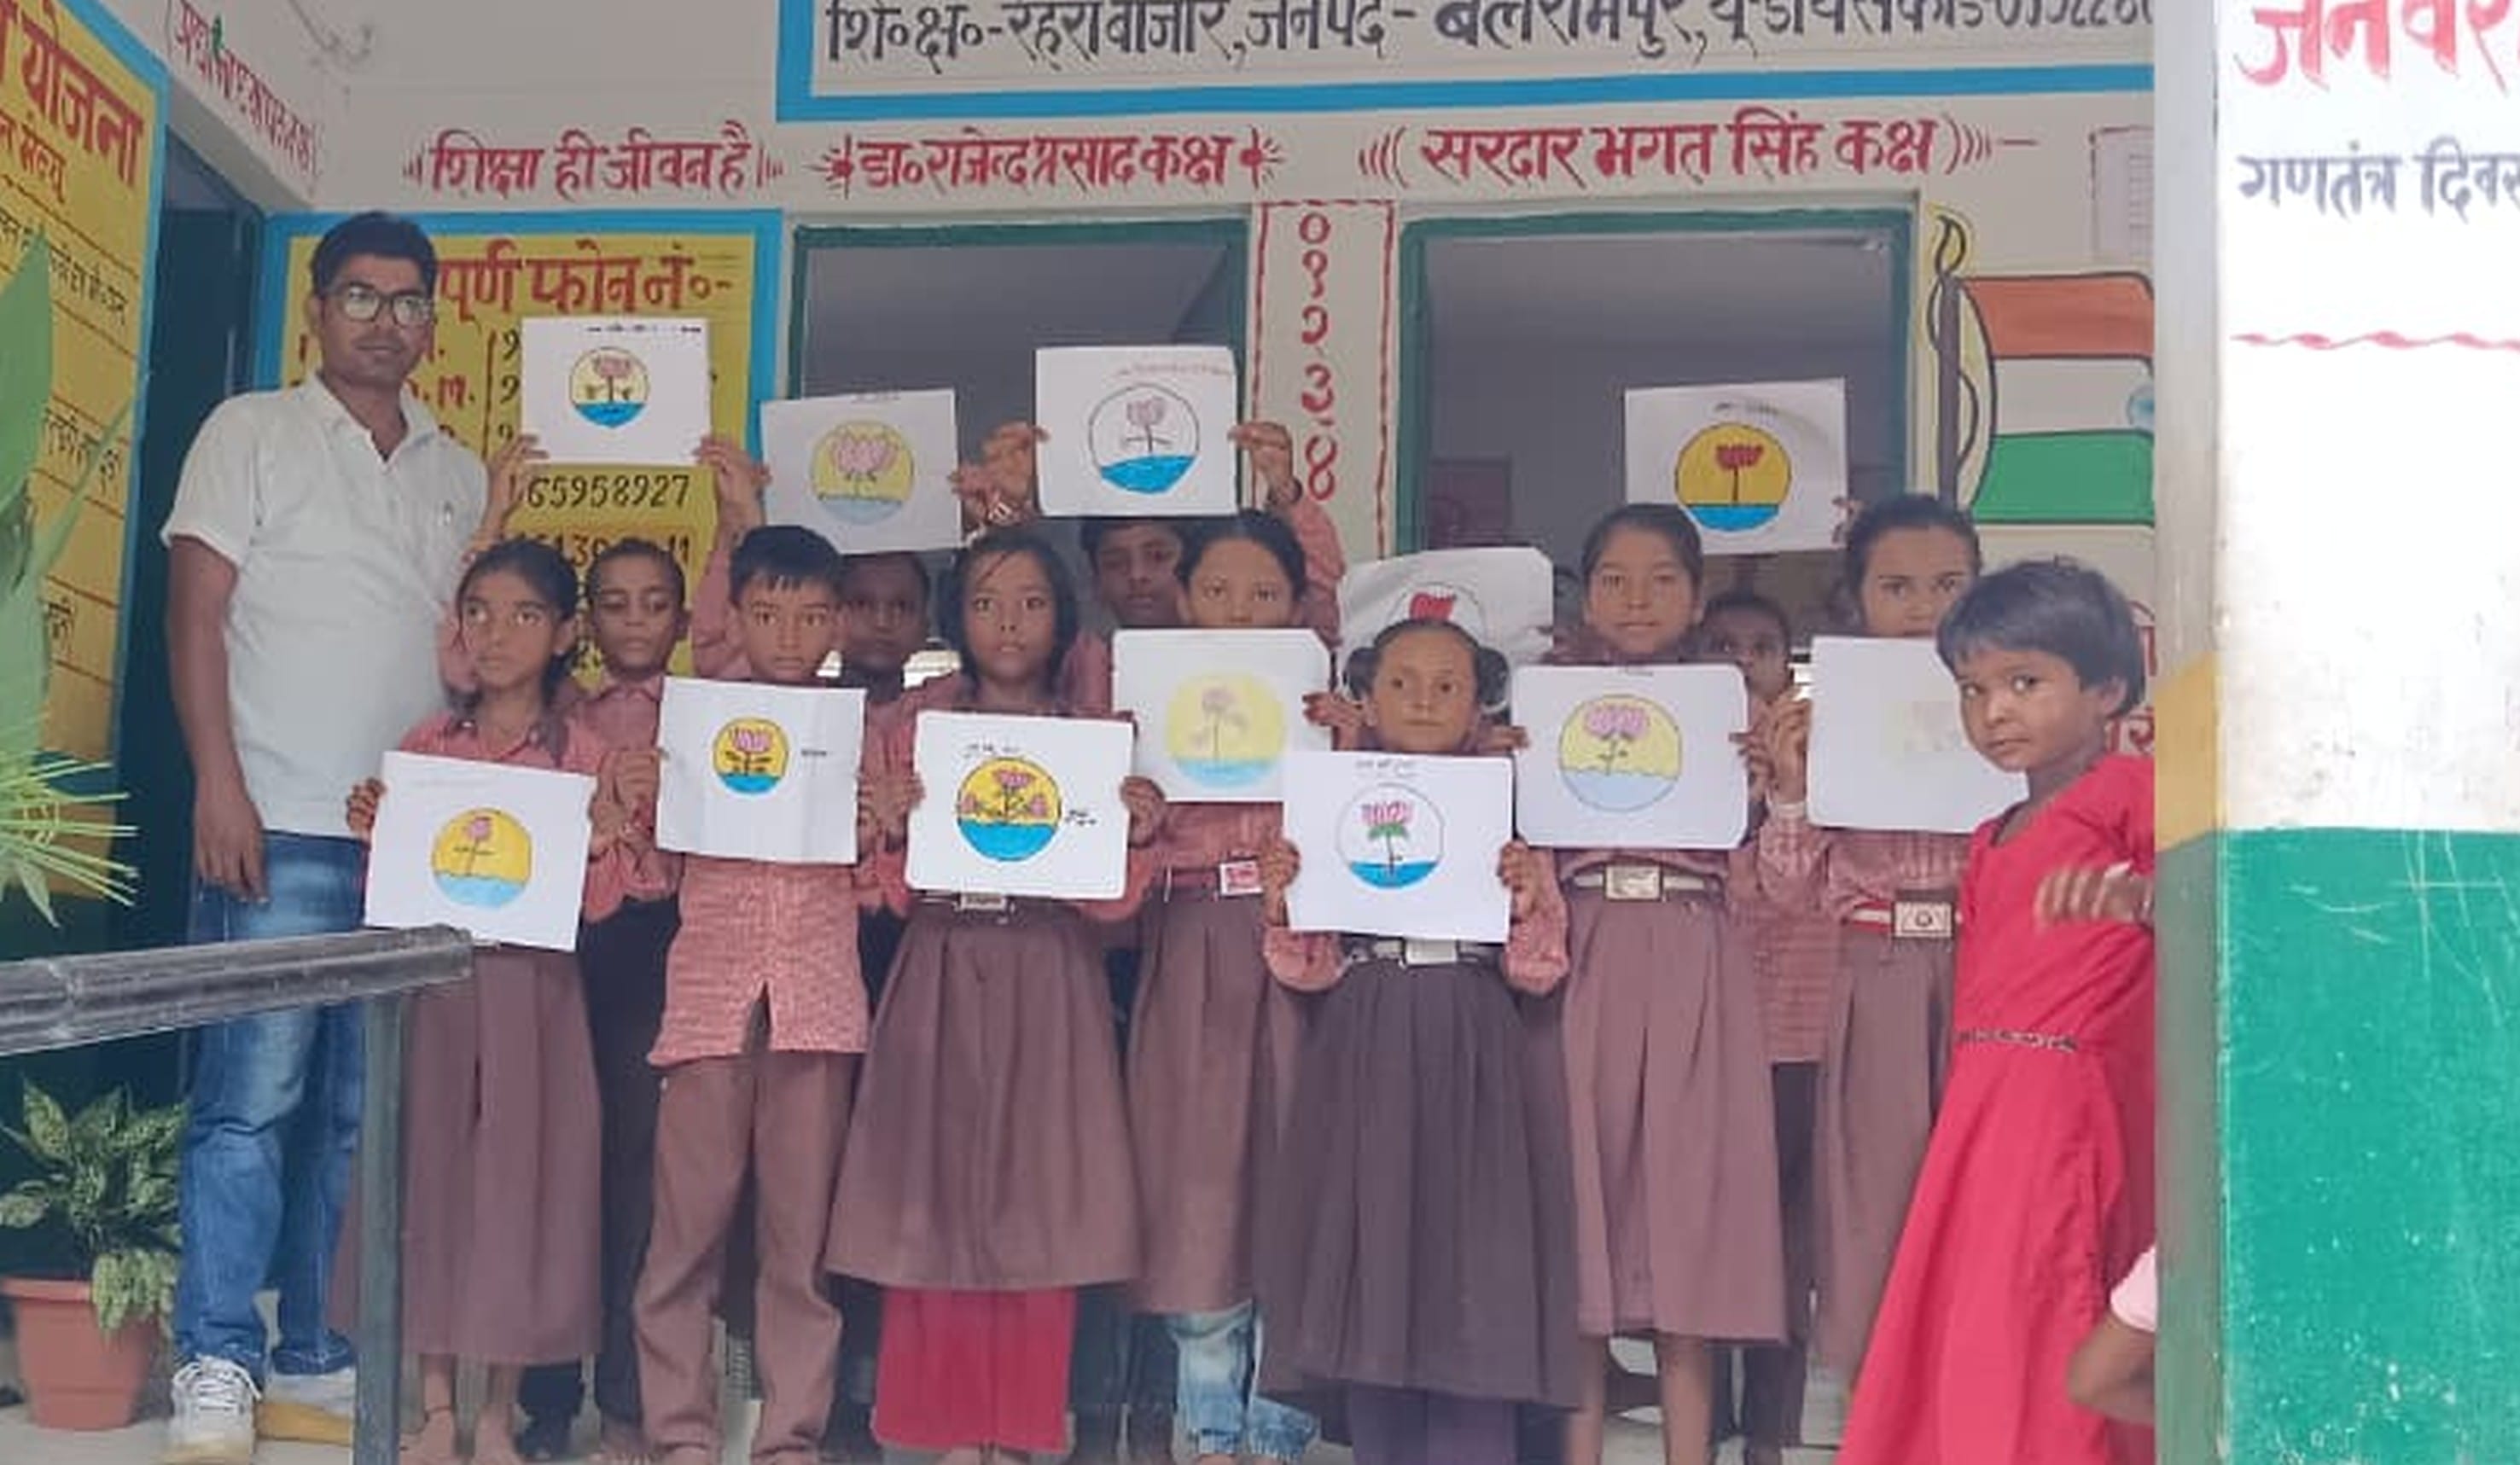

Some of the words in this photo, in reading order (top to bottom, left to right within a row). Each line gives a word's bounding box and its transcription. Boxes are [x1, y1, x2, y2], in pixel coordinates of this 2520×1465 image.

[429, 128, 545, 201] शिक्षा
[554, 128, 608, 202] ही
[602, 126, 723, 192] जीवन
[1140, 135, 1235, 186] कक्ष
[1420, 129, 1587, 189] सरदार
[1590, 125, 1718, 184] भगत
[1724, 106, 1825, 181] सिंह
[1836, 119, 1938, 175] कक्ष
[2236, 138, 2401, 221] गणतंत्र
[526, 237, 642, 314] फोन
